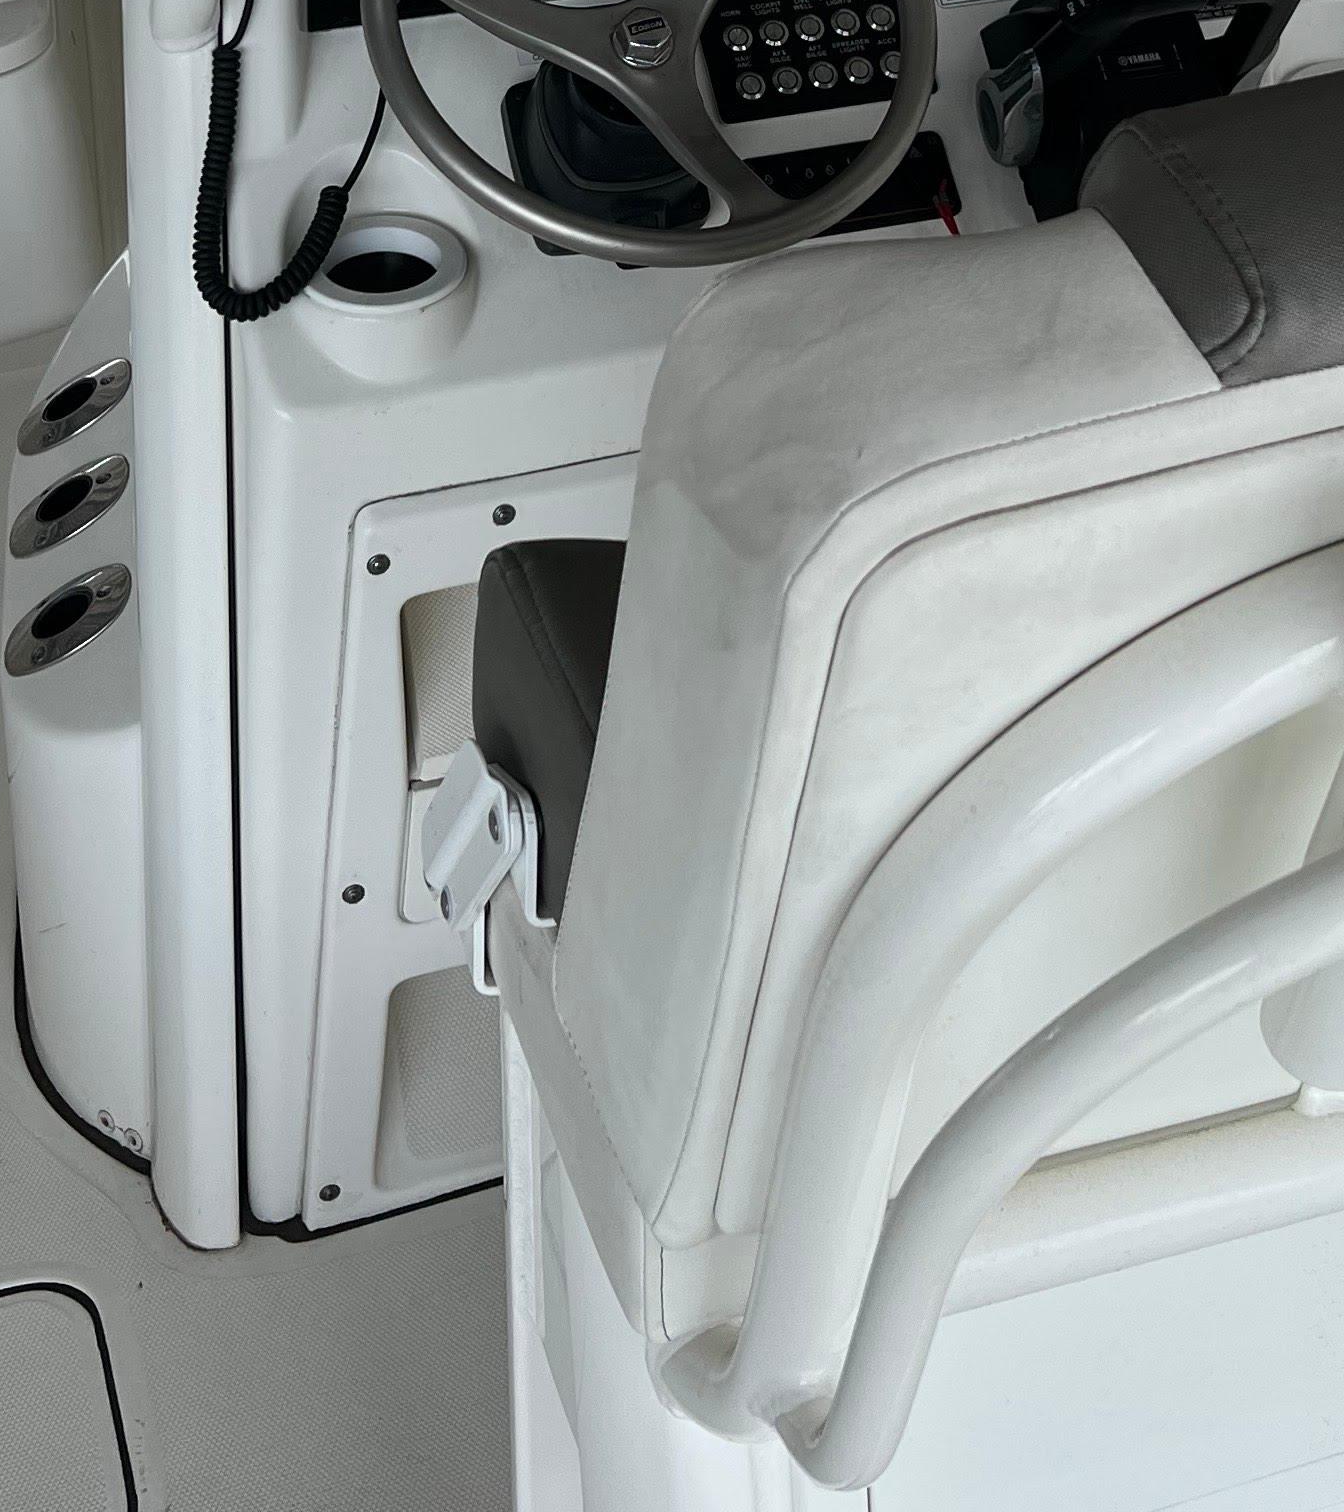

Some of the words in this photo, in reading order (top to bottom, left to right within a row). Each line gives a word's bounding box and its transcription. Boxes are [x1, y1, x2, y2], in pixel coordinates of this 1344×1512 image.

[750, 1, 781, 11] COCKPIT
[793, 3, 814, 11] WELL
[753, 7, 781, 16] LIGHTS
[630, 20, 664, 35] EDSON
[838, 44, 865, 54] LIGHTS
[1127, 51, 1162, 65] YAMAHA
